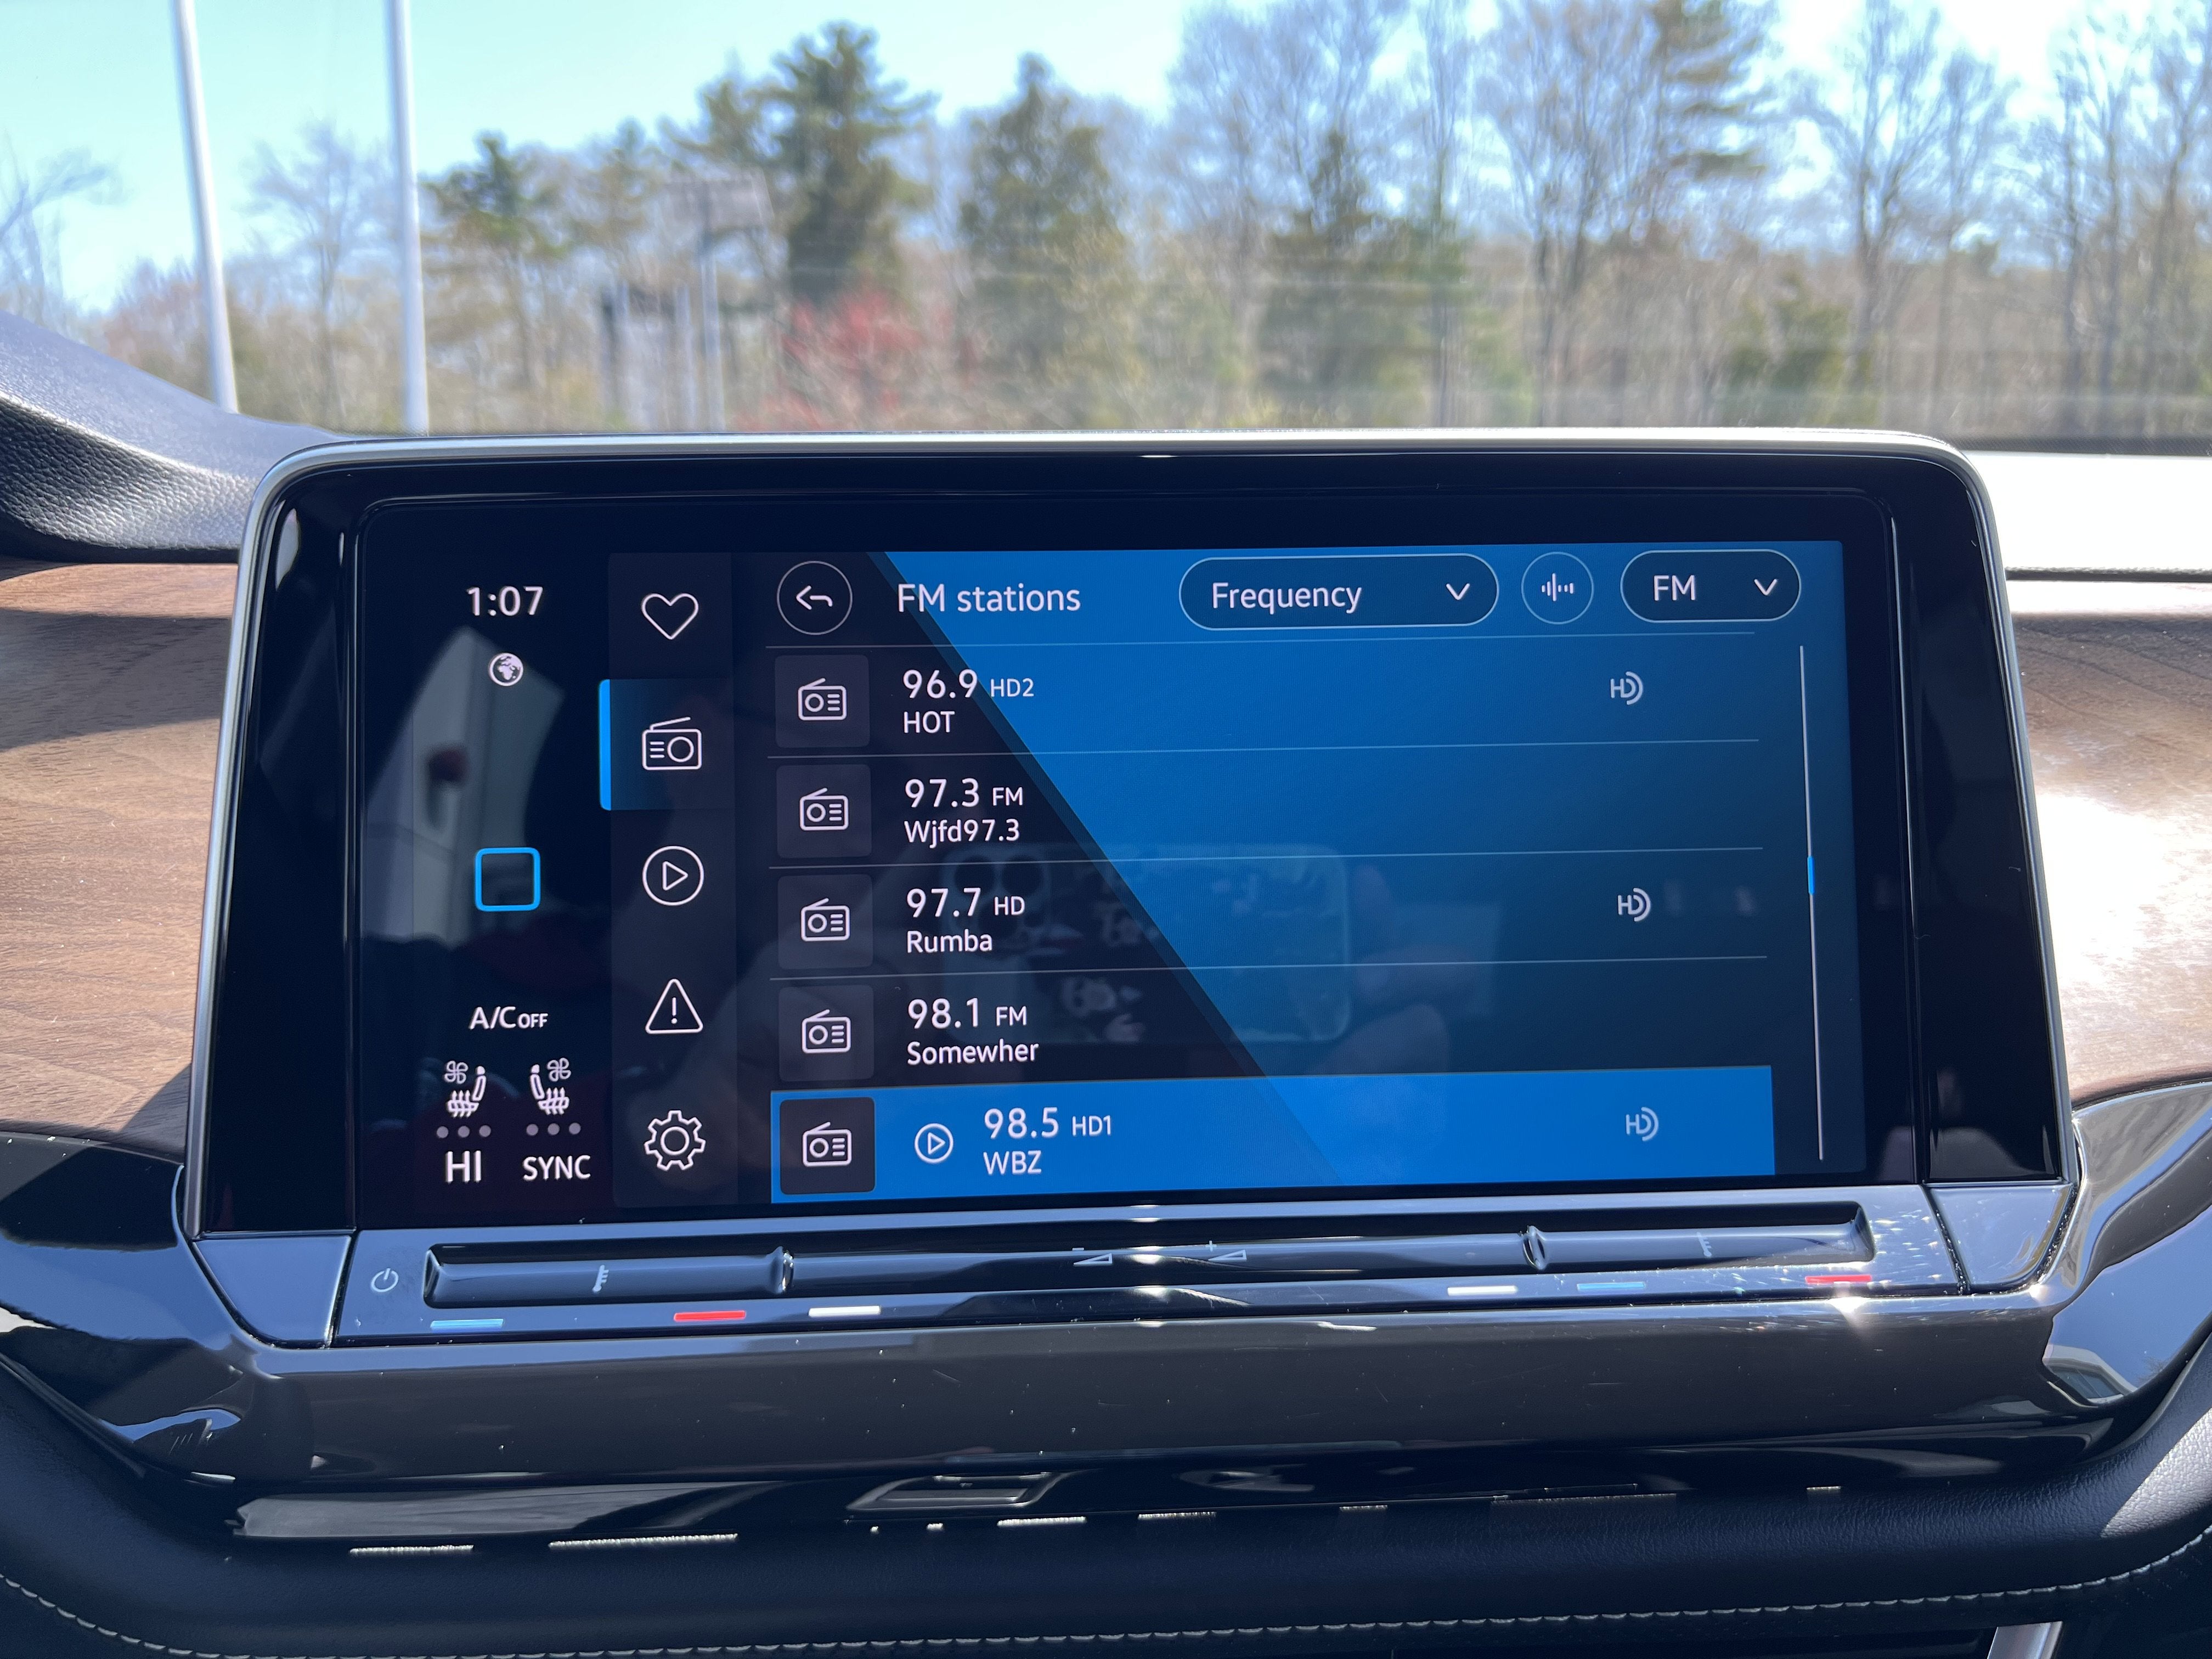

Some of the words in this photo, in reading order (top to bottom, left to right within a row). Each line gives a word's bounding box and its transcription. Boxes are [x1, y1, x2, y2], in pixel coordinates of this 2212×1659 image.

[469, 586, 544, 617] 1:07
[899, 584, 945, 613] FM
[957, 583, 1081, 613] stations
[1213, 583, 1363, 616] Frequency
[1654, 575, 1696, 602] FM
[904, 669, 978, 699] 96.9
[991, 678, 1035, 698] HD2
[904, 711, 956, 734] HOT
[906, 778, 980, 808] 97.3
[993, 787, 1024, 806] FM
[904, 819, 1020, 849] Wjfd97.3
[907, 888, 981, 918] 97.7
[995, 896, 1025, 916] HD
[907, 929, 993, 954] Rumba
[909, 998, 979, 1030] 98.1
[996, 1006, 1028, 1027] FM
[908, 1039, 1040, 1066] Somewher
[985, 1107, 1059, 1139] 98.5
[1073, 1115, 1111, 1137] HD1
[447, 1150, 482, 1183] HI
[523, 1155, 591, 1181] SYNC
[984, 1150, 1042, 1175] WBZ
